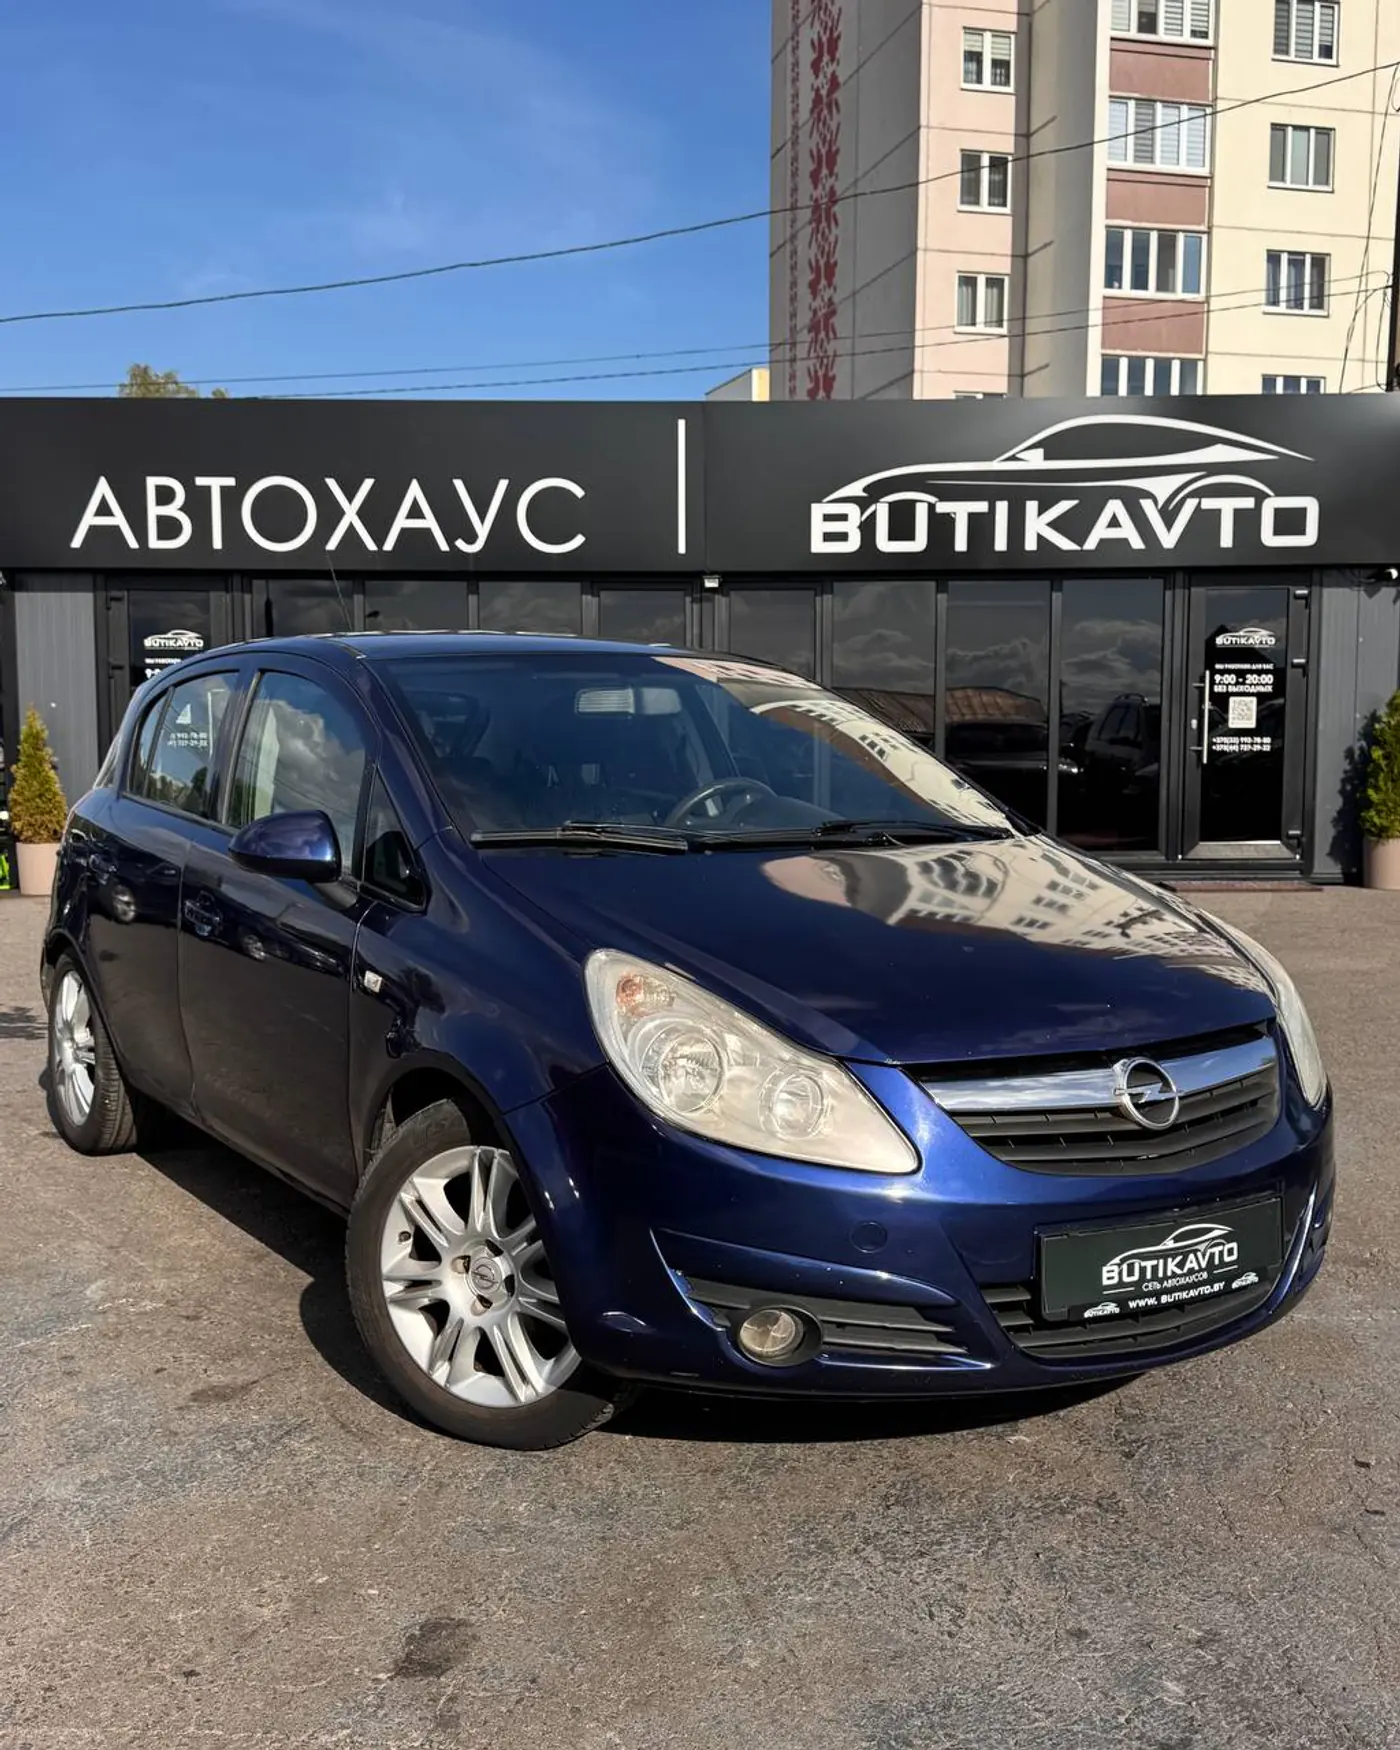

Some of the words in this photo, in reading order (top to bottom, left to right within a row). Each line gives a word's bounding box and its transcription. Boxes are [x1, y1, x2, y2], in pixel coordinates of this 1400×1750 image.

[70, 475, 586, 554] АВТОХАУС
[810, 496, 1319, 554] BUTIKAVTO
[143, 637, 204, 647] BUTIKAVTO
[1215, 636, 1276, 645] BUTIKAVTO
[1213, 674, 1236, 684] 9:00
[1245, 674, 1274, 684] 20:00
[1102, 1242, 1238, 1286] BUTIKAVTO
[1142, 1281, 1161, 1291] СЕТЬ
[1162, 1271, 1208, 1288] АВТОХАУСОВ
[1128, 1297, 1158, 1309] WWW.
[1160, 1281, 1225, 1303] BUTIKAVTO.BY
